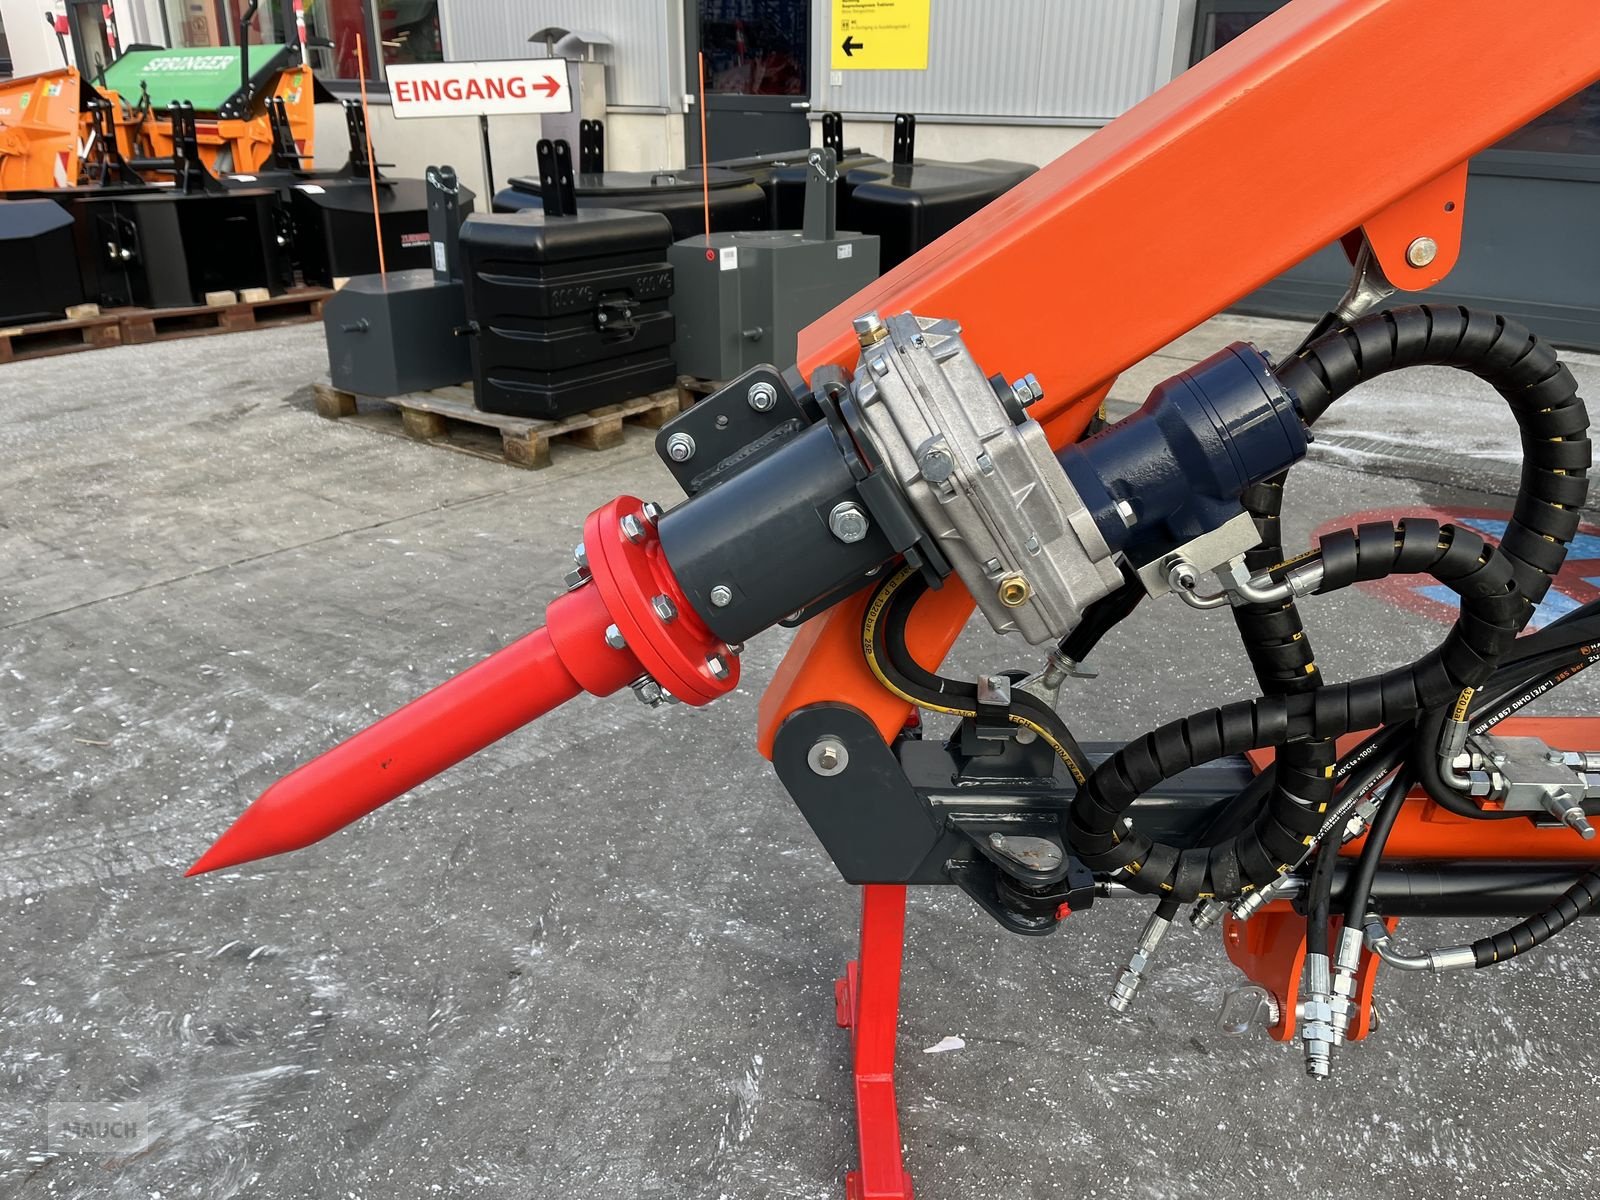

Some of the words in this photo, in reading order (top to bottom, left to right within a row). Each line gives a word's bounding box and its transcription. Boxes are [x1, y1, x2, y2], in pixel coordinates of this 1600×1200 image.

[143, 55, 234, 71] SPRINGER
[395, 77, 526, 102] EINGANG
[870, 597, 884, 617] 1320
[864, 617, 875, 632] bar
[1475, 724, 1489, 735] DIN
[1488, 715, 1499, 725] EN
[1498, 707, 1512, 719] 857
[1513, 695, 1531, 710] DN10
[1555, 671, 1570, 682] 385
[1571, 662, 1585, 672] bar
[1053, 743, 1067, 758] DIN
[1065, 758, 1076, 770] EN
